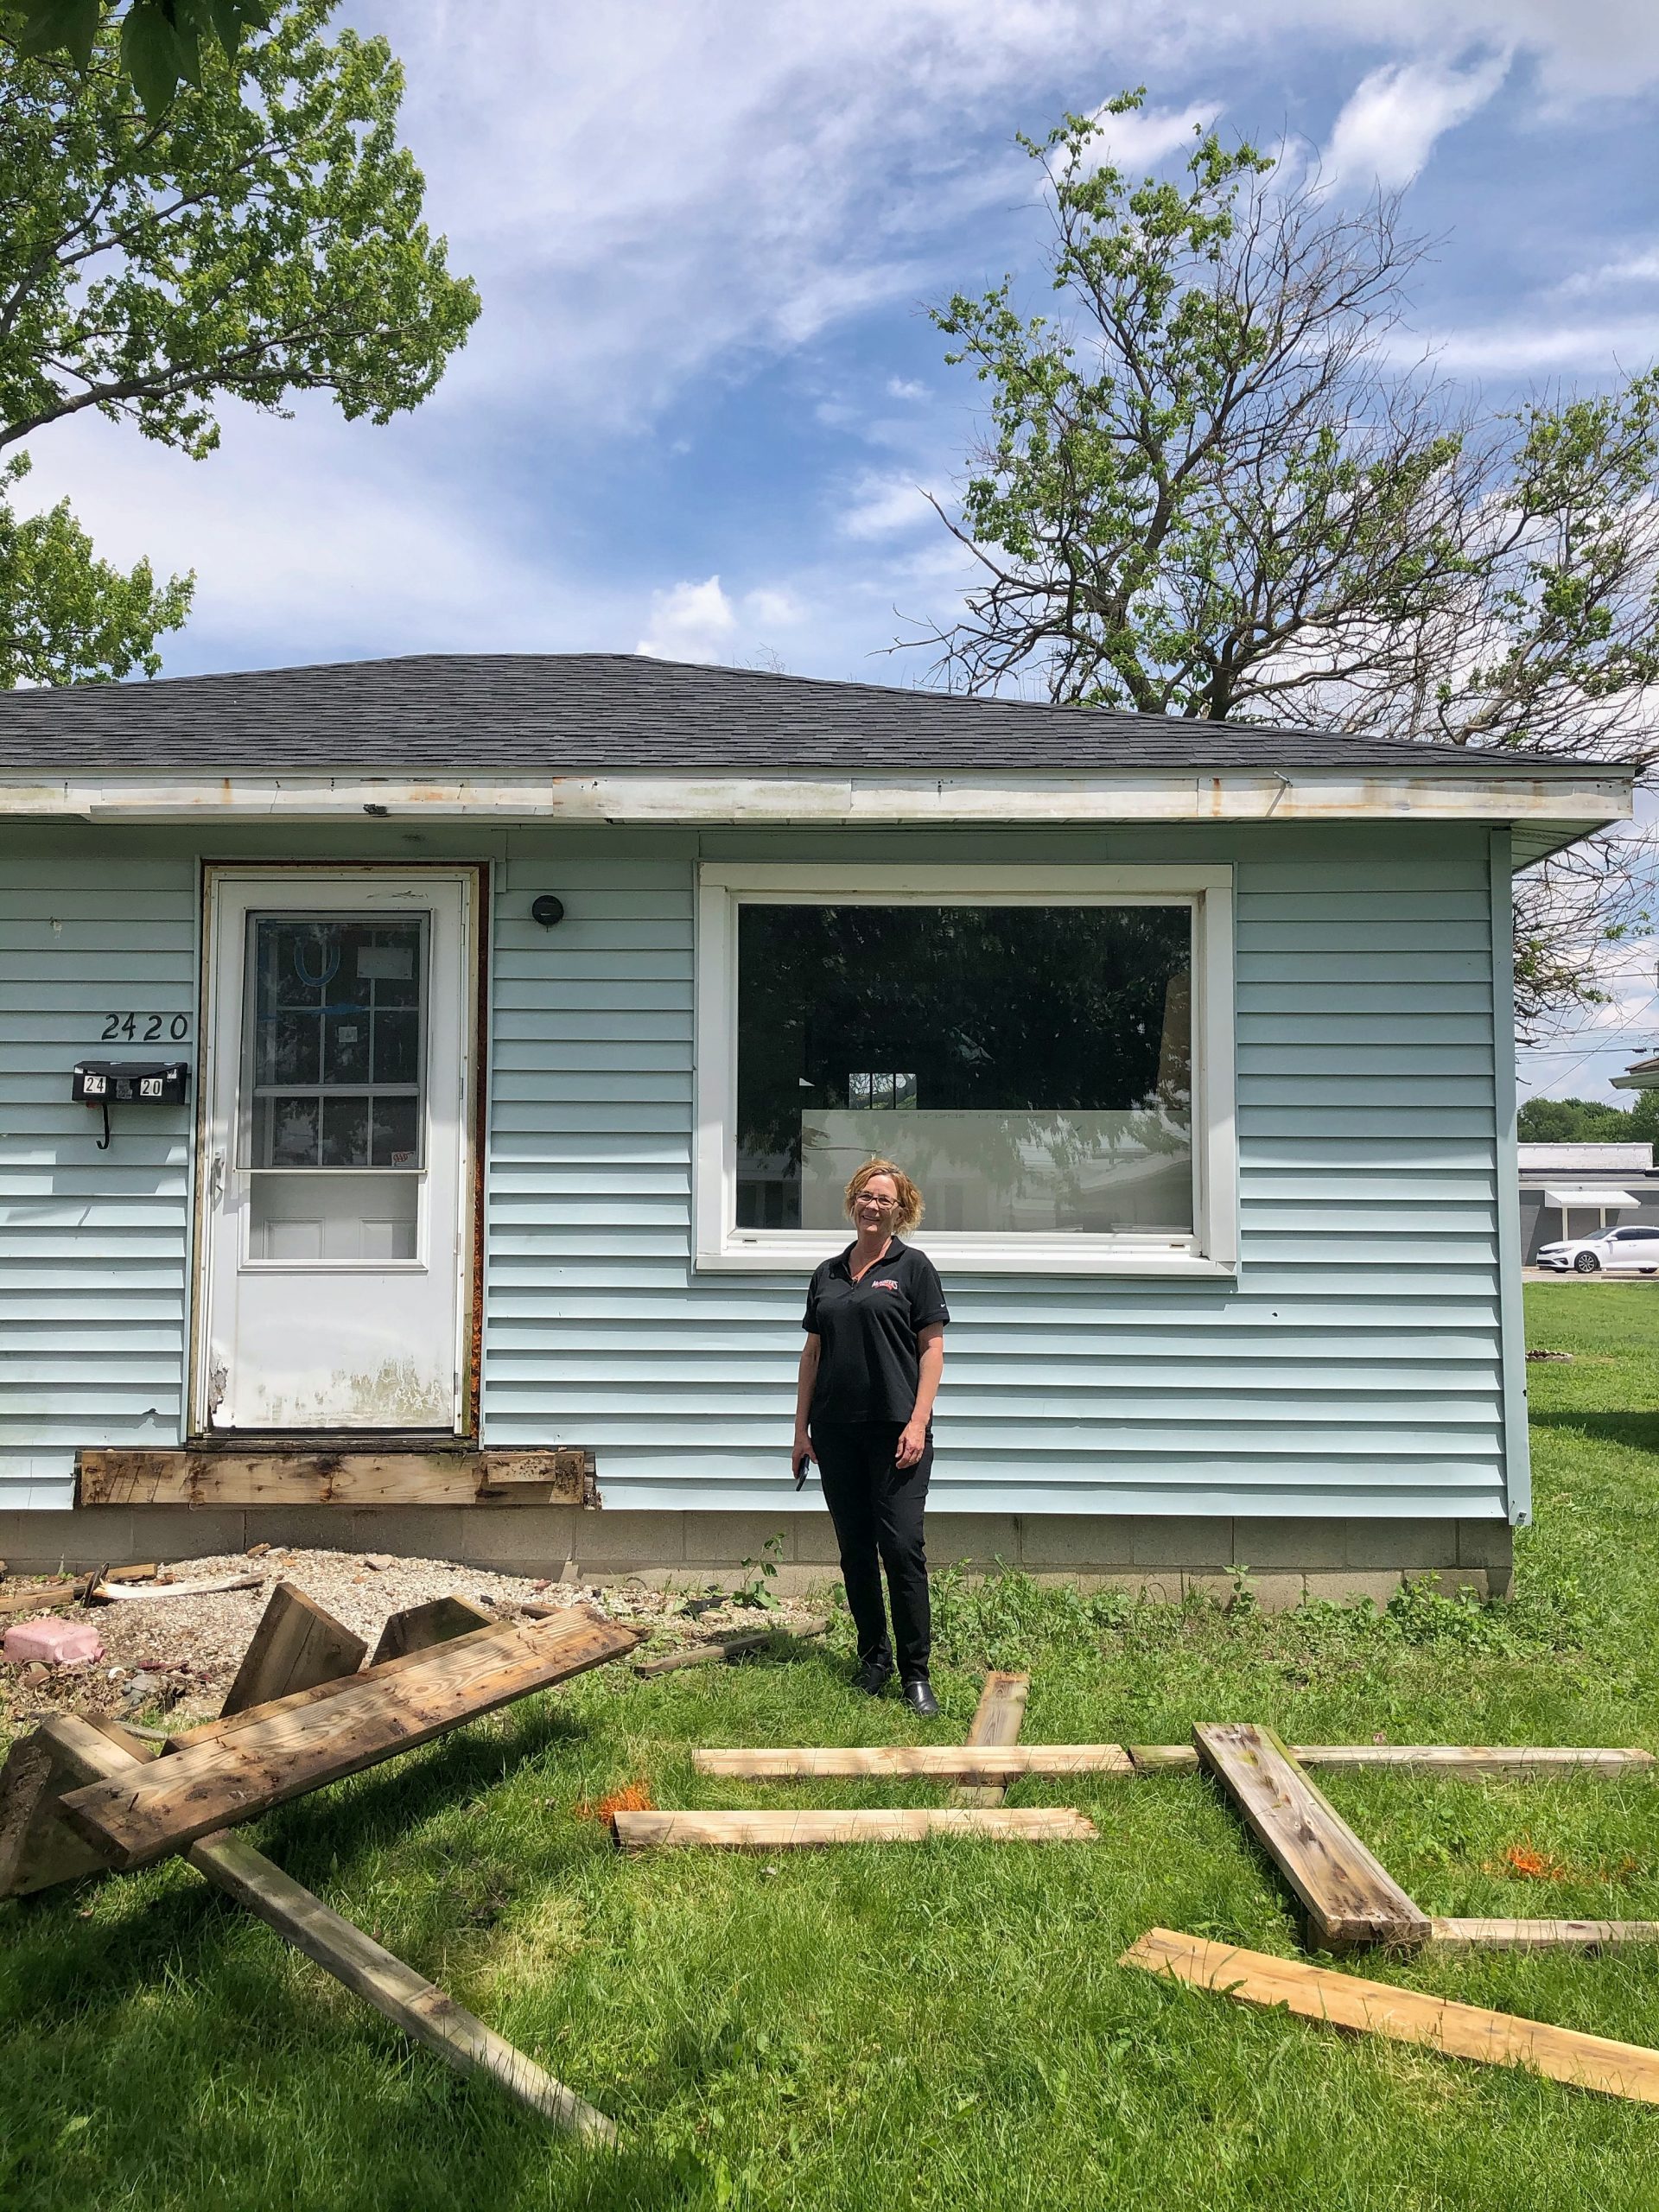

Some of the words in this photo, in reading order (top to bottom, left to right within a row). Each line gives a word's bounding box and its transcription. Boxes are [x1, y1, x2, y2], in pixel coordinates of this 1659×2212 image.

[101, 1012, 188, 1041] 2420
[86, 1077, 105, 1092] 24
[142, 1079, 161, 1095] 20
